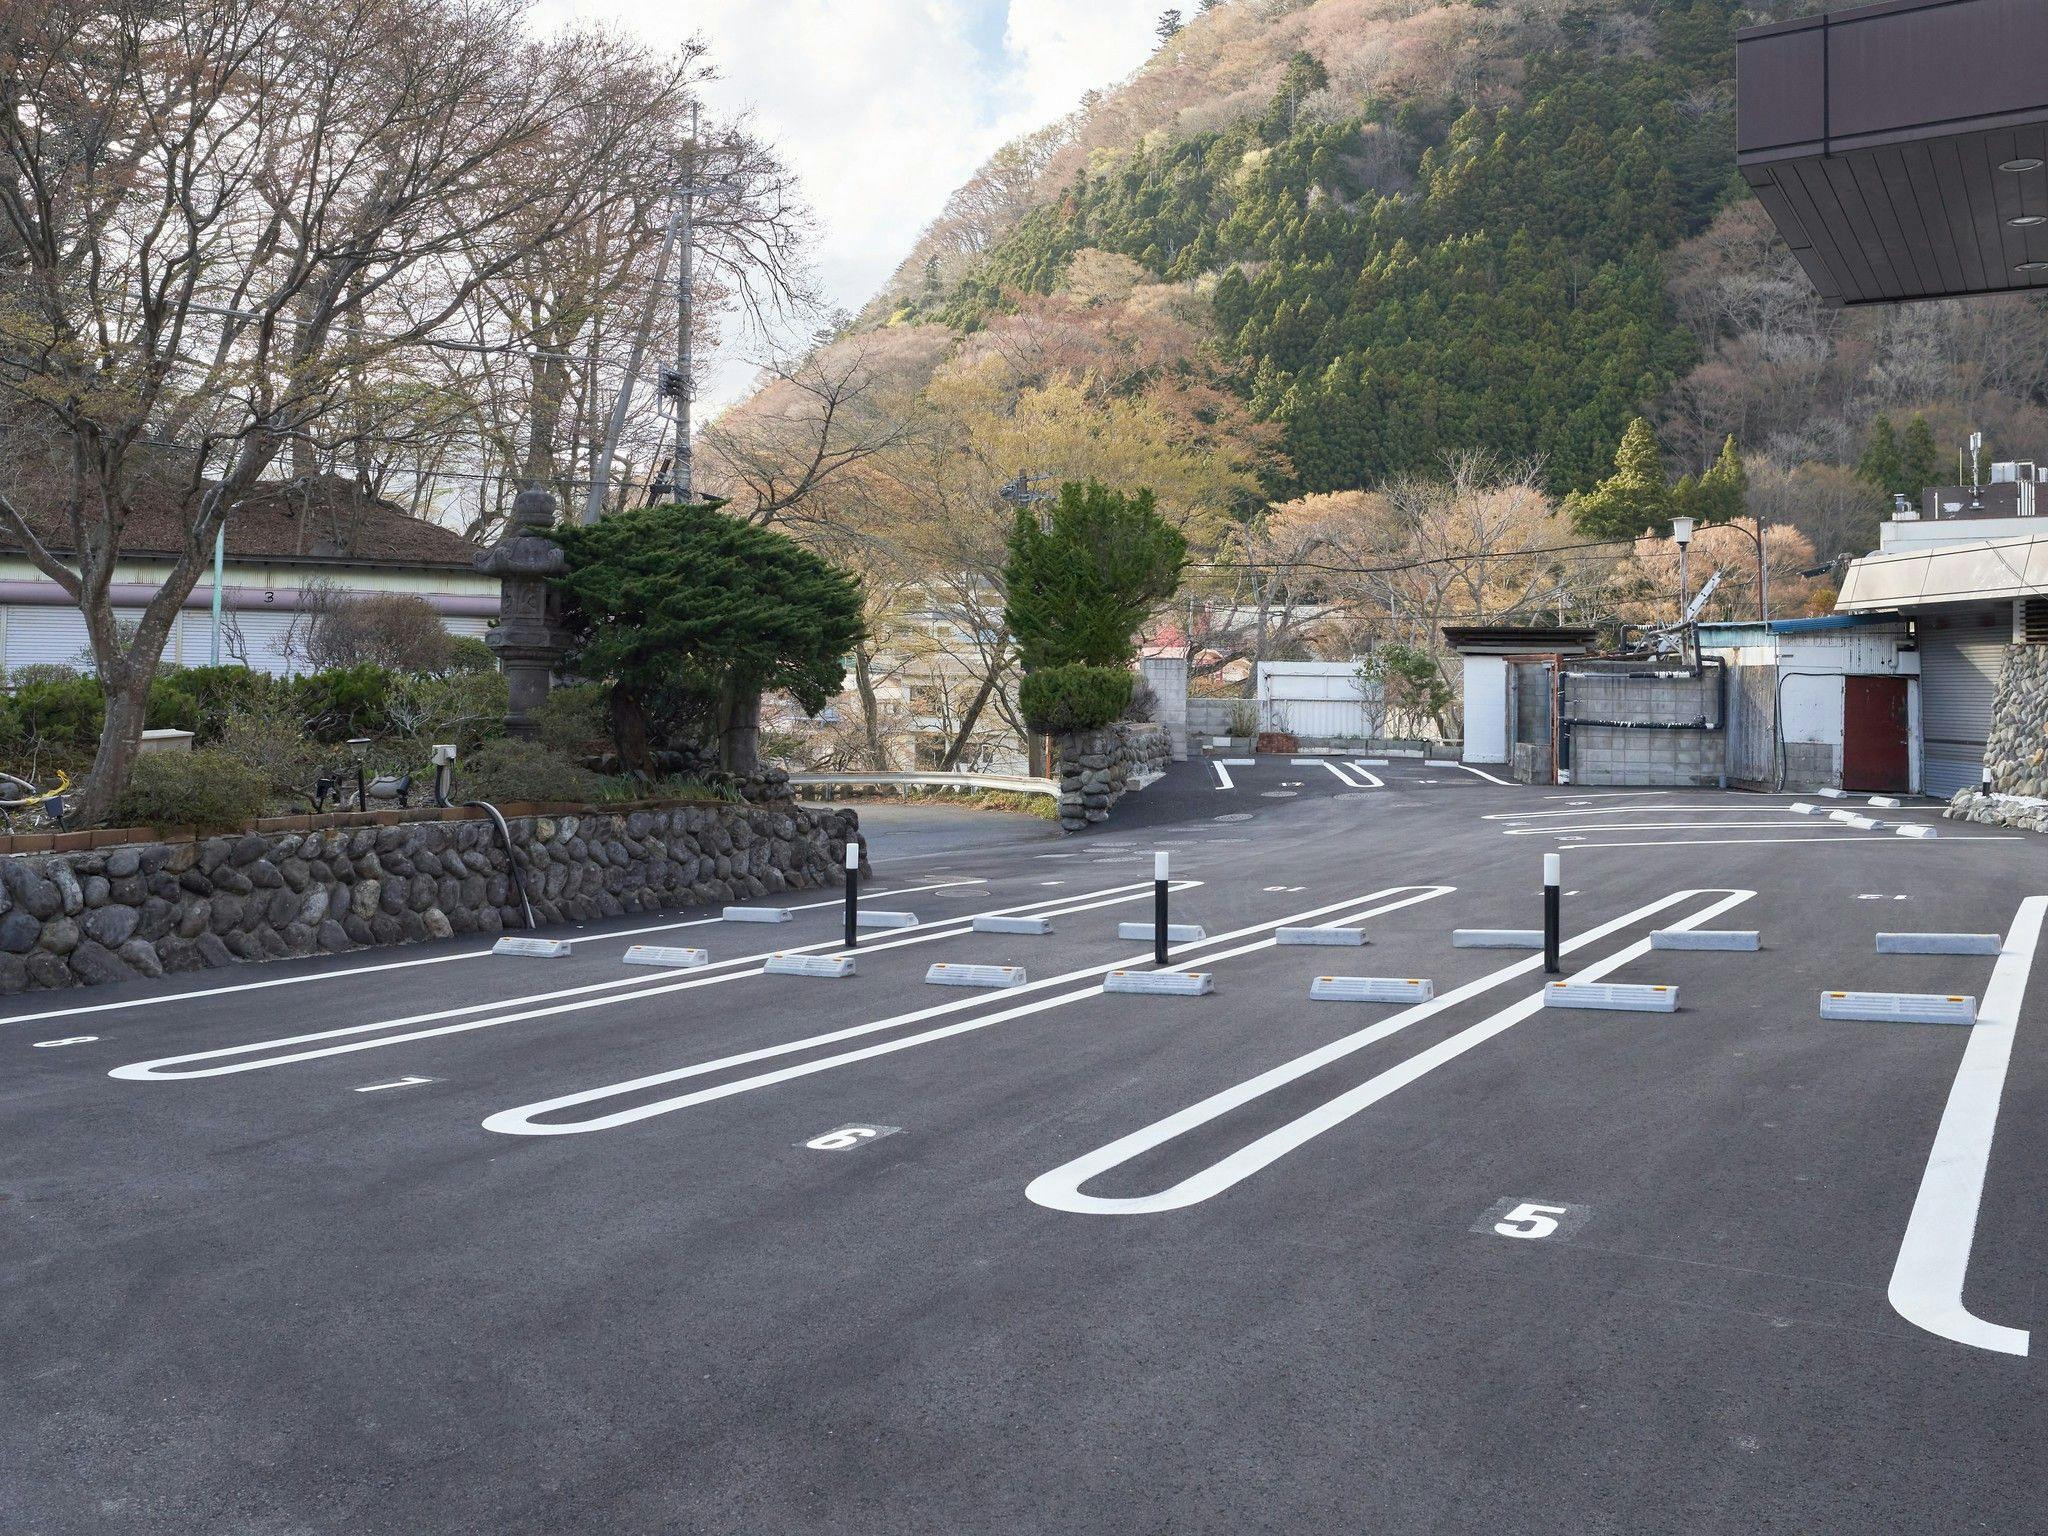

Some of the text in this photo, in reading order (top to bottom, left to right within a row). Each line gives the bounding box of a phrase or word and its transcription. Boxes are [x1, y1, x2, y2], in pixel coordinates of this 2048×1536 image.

[264, 591, 274, 603] 3
[32, 1036, 99, 1048] 8
[806, 1128, 877, 1150] 6
[1494, 1203, 1567, 1239] 5
